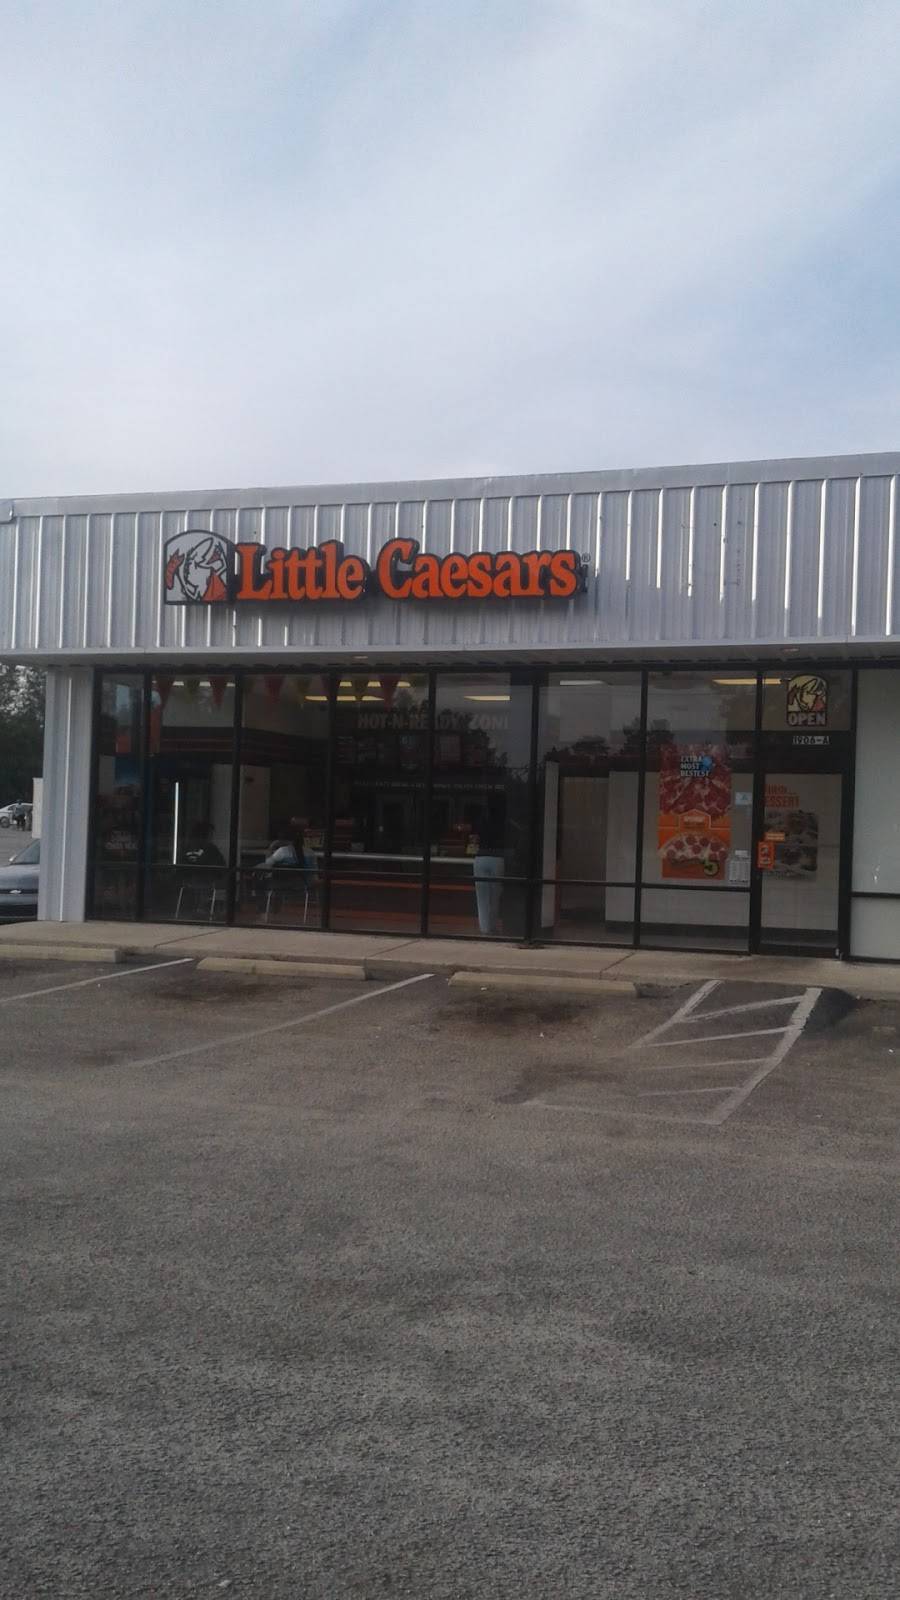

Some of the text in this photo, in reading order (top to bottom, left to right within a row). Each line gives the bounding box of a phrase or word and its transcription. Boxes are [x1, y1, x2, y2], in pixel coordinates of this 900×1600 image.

[235, 537, 578, 600] Little Caesars
[788, 712, 826, 726] OPEN
[793, 736, 829, 745] 1906-A
